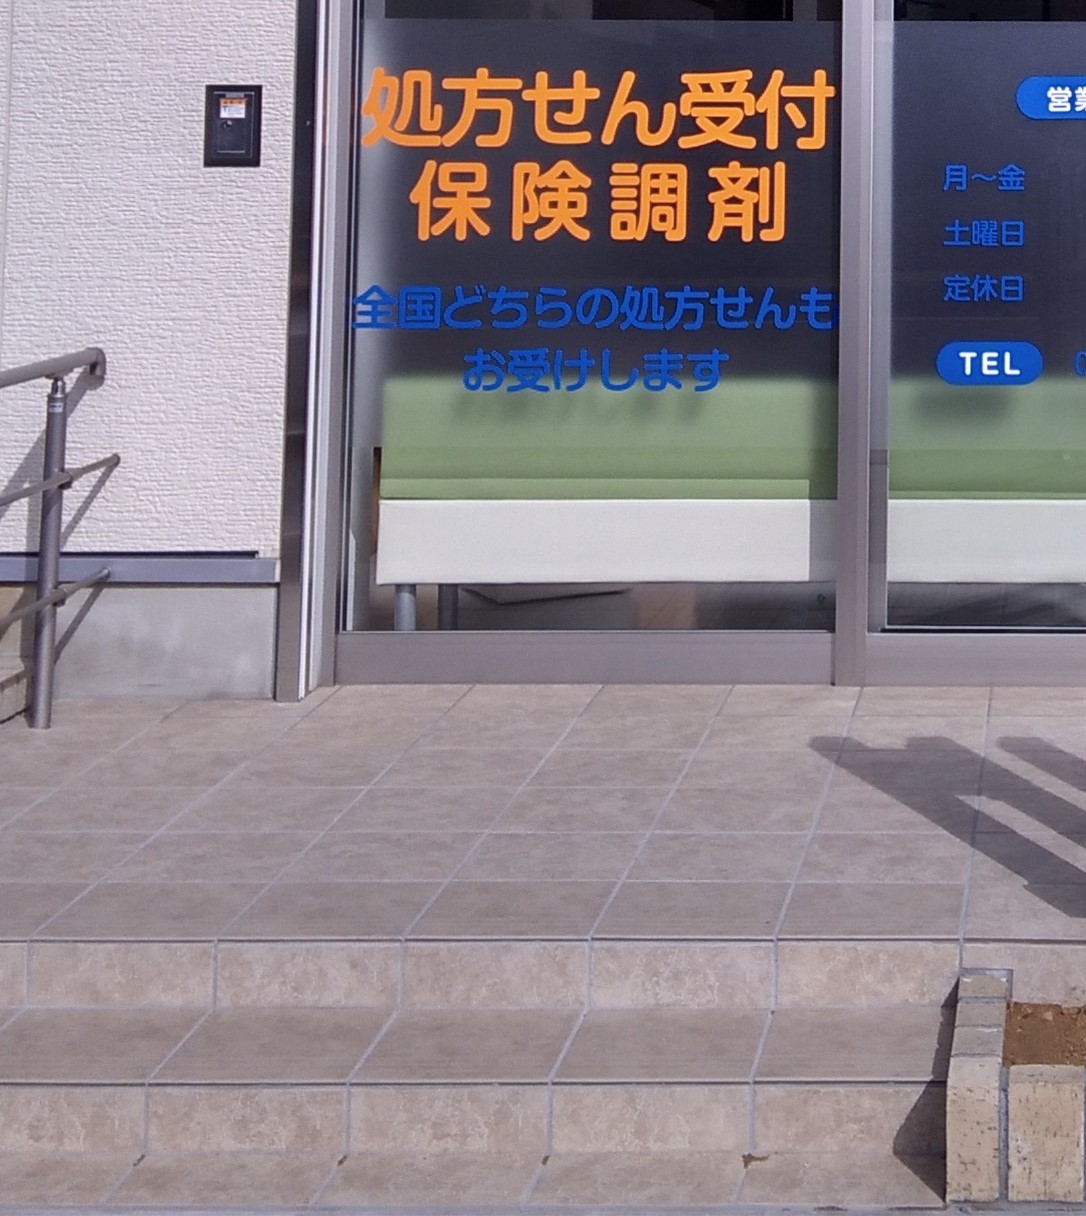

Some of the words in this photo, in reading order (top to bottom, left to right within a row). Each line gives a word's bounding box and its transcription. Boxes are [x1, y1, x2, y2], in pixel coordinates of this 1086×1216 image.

[361, 67, 836, 150] 処方せん受付
[409, 159, 786, 242] 保険調剤
[943, 220, 1025, 247] 土曜日
[352, 285, 834, 330] 全国どちらの処方せんも
[943, 274, 1025, 302] 定休日
[462, 348, 730, 392] お受けします
[958, 352, 1021, 376] TEL
